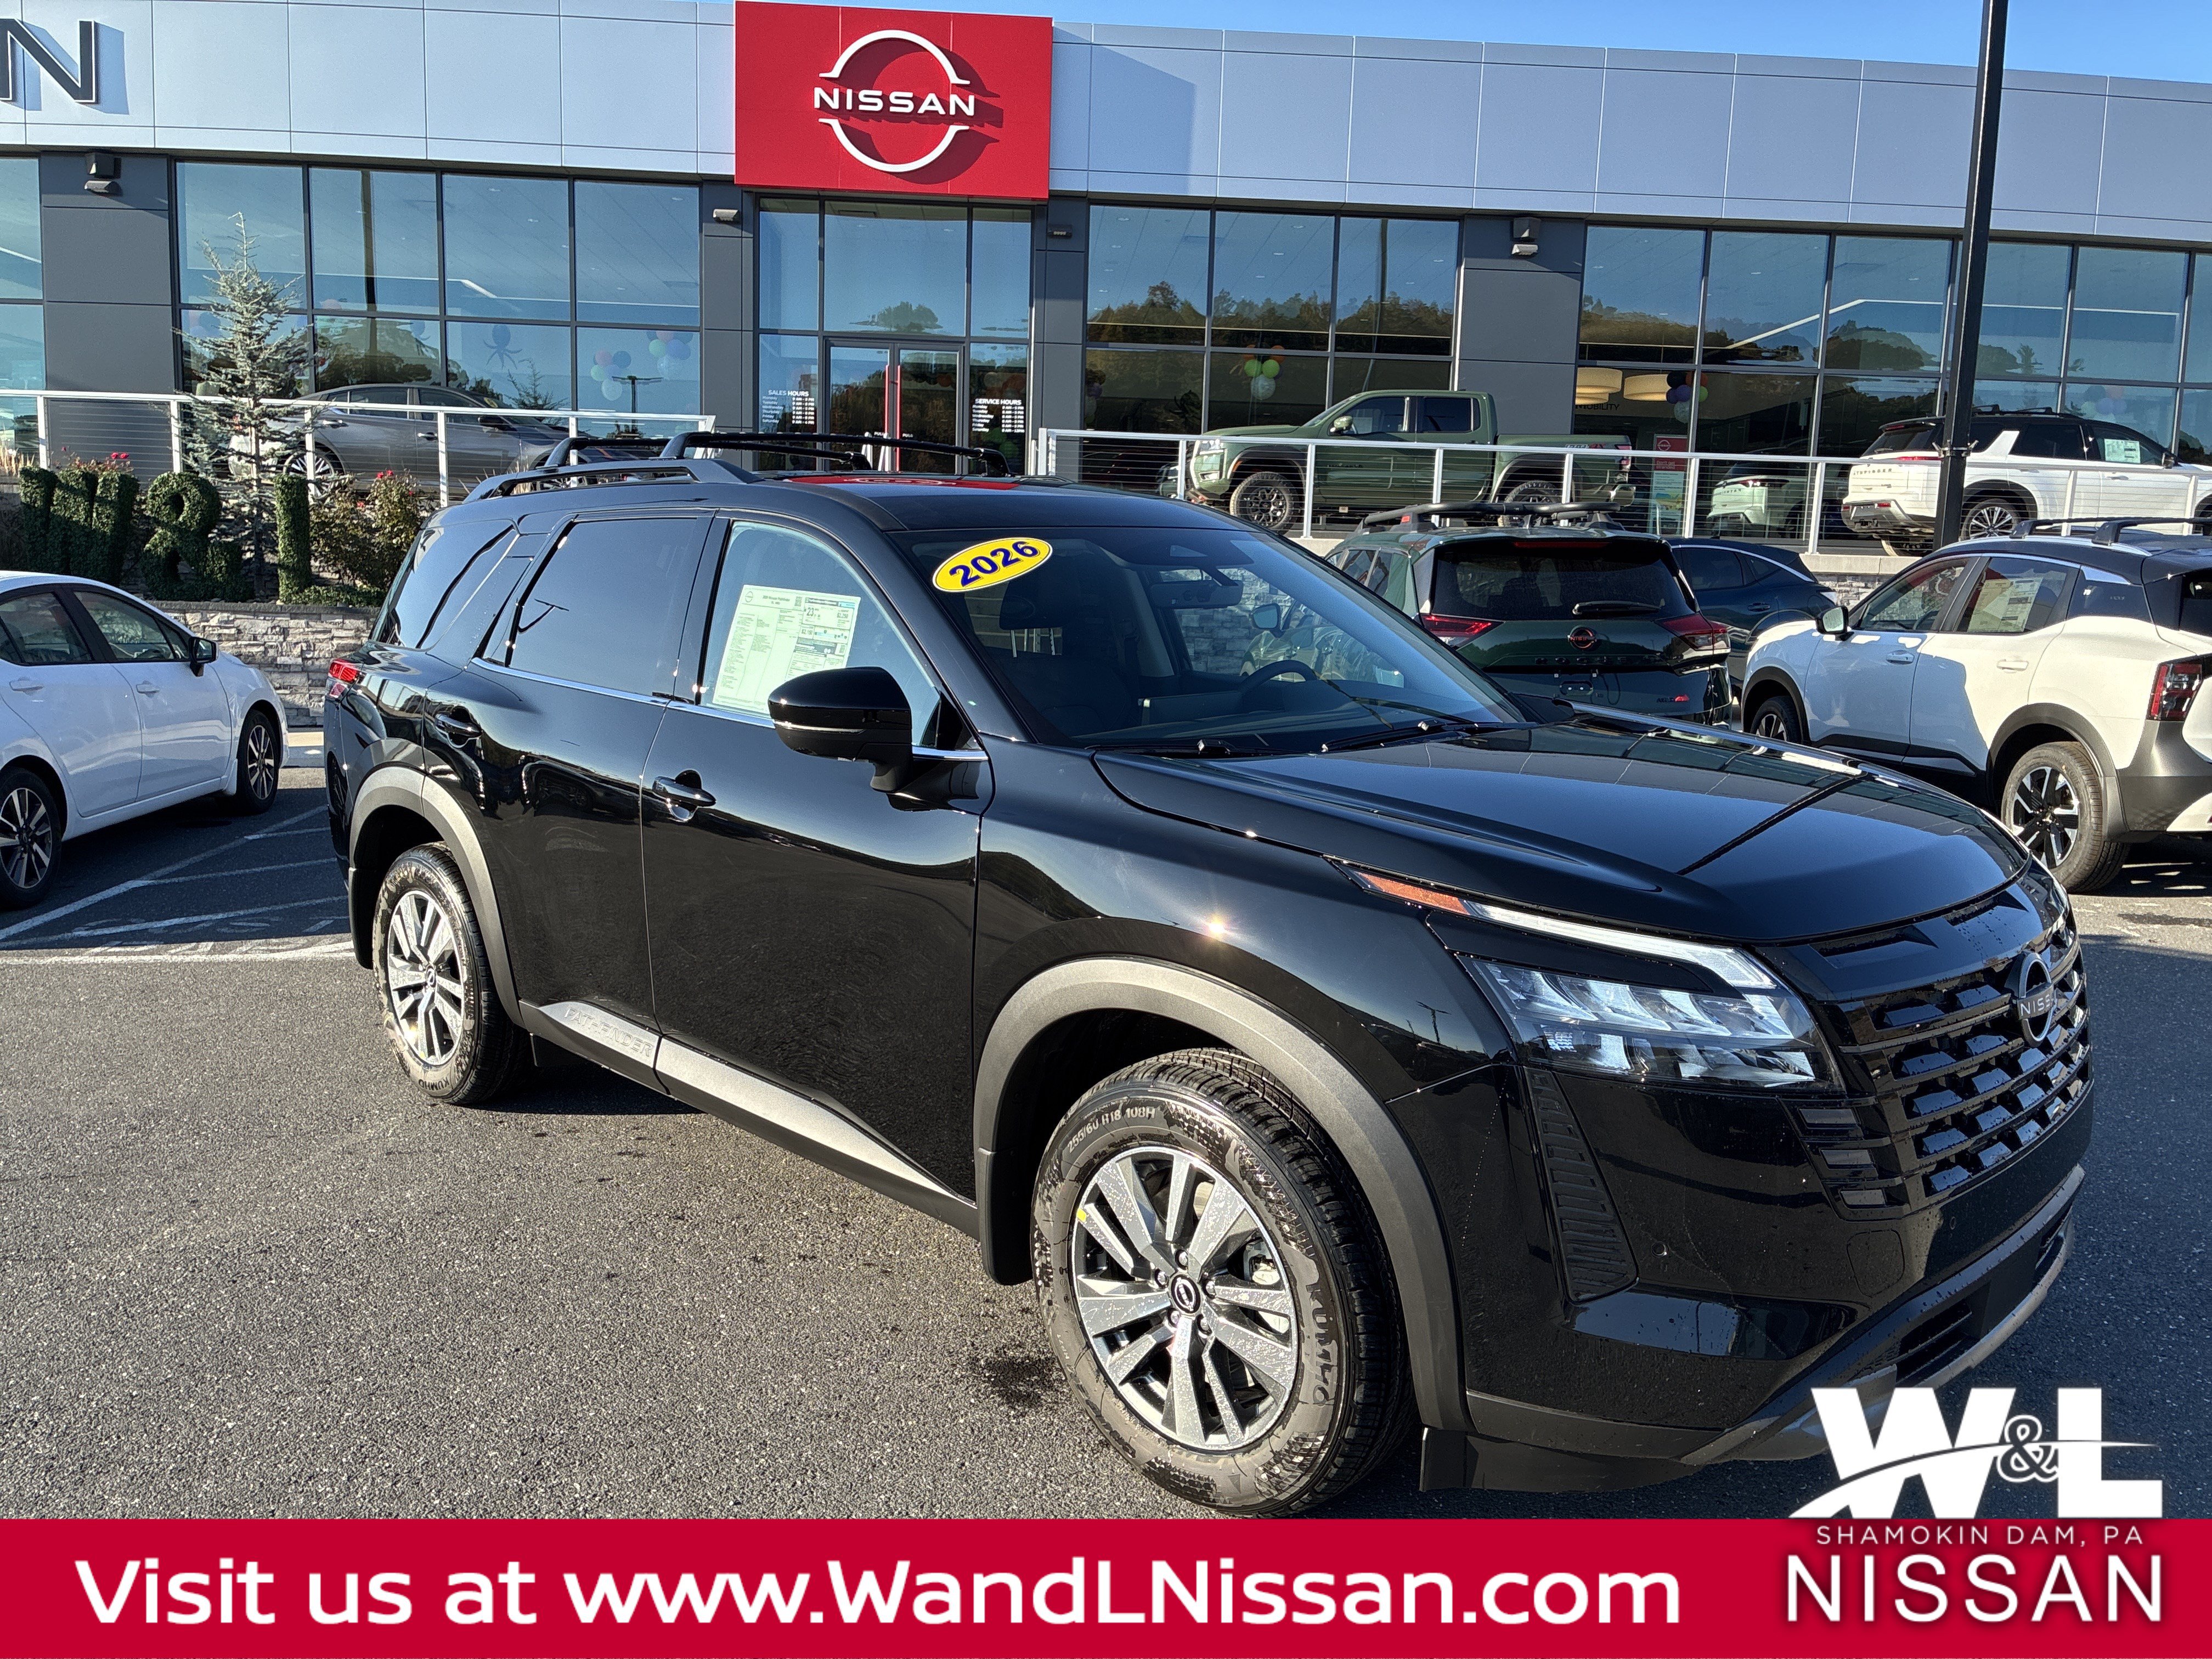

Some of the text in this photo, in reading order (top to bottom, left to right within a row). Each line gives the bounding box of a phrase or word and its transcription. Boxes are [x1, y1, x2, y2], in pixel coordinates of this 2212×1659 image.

[0, 19, 95, 103] N
[814, 87, 975, 117] NISSAN
[949, 541, 1040, 588] 2026
[563, 1007, 654, 1057] PATHFINDER
[418, 1076, 450, 1091] KUMHO
[1066, 1118, 1099, 1154] 255/60
[1101, 1109, 1121, 1125] R18
[1125, 1106, 1156, 1120] 108H
